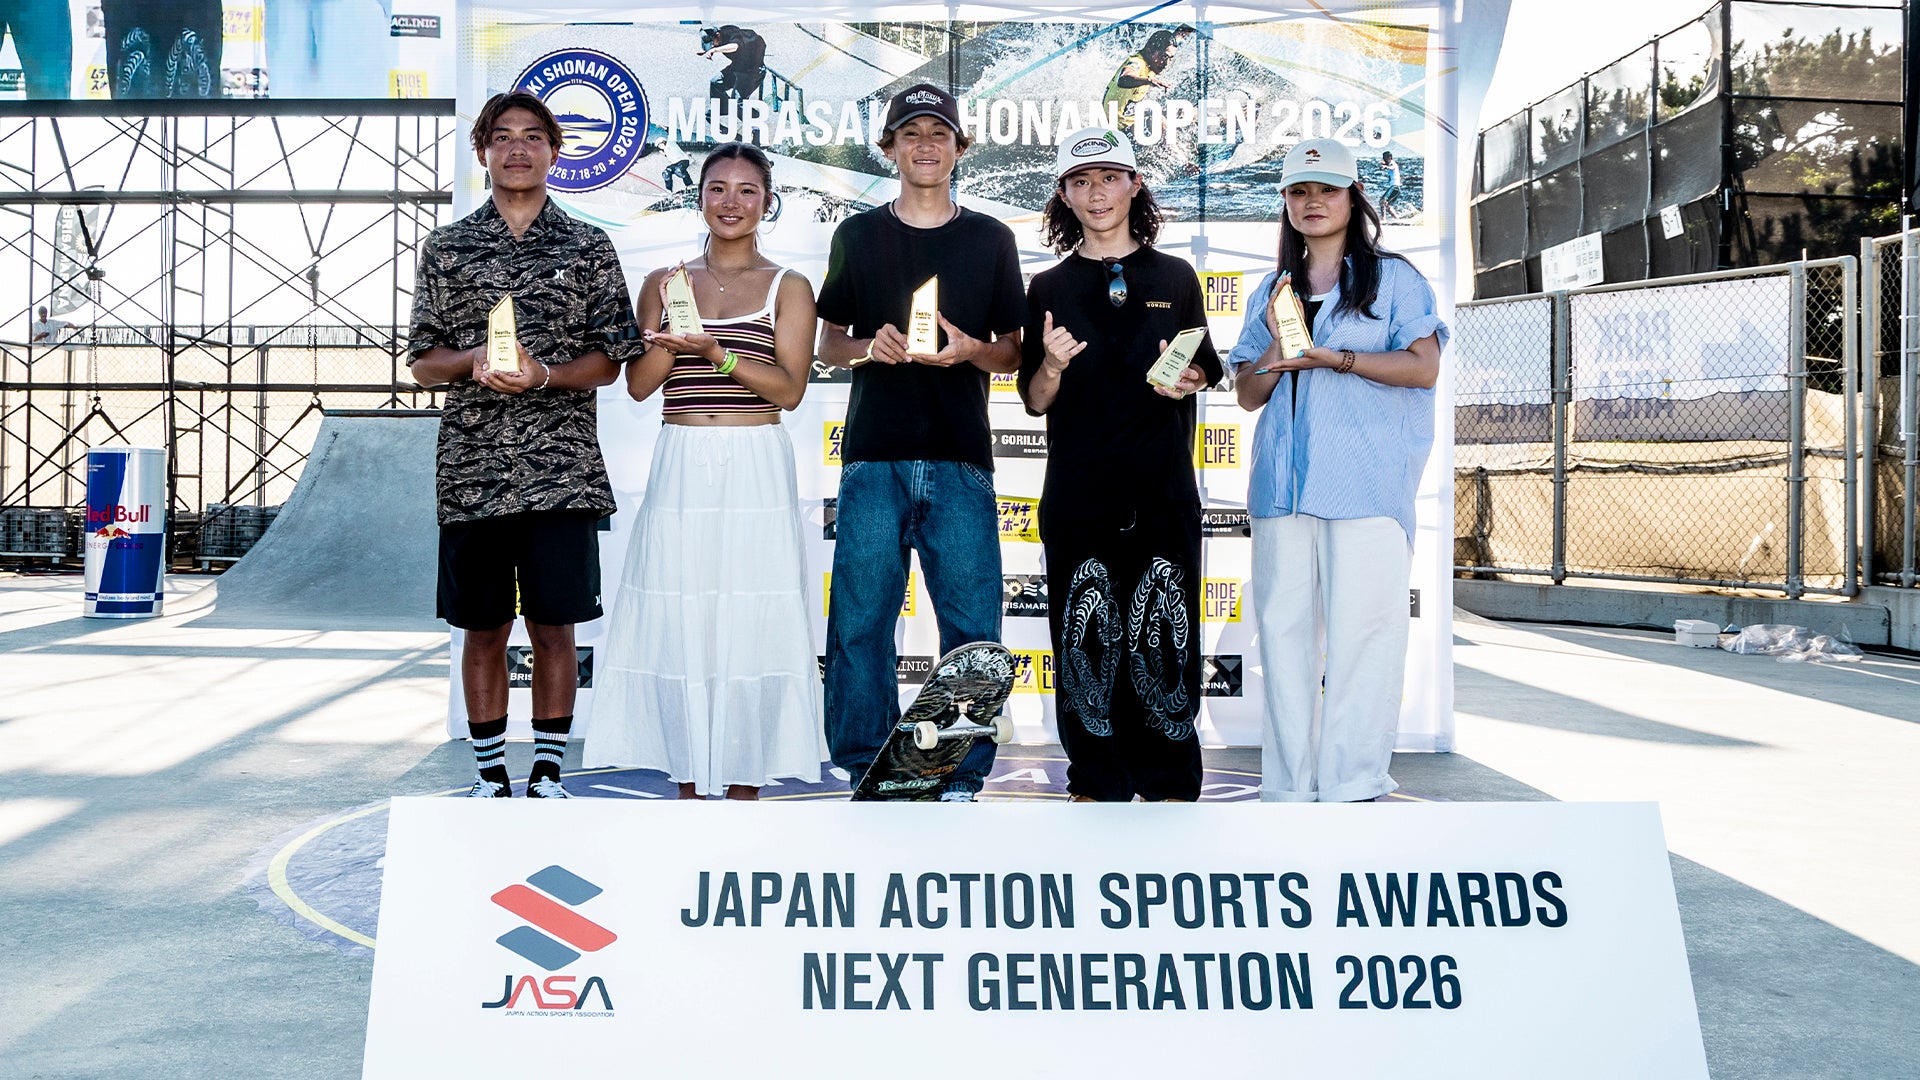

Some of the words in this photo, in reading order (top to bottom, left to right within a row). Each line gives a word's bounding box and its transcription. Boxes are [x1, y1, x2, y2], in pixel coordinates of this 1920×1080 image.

[543, 60, 609, 82] SHONAN
[607, 74, 637, 113] OPEN
[668, 96, 893, 146] MURASAK
[958, 99, 1119, 146] HONAN
[1134, 100, 1257, 146] OPEN
[1271, 101, 1393, 149] 2026
[612, 116, 638, 158] 2026
[548, 162, 607, 180] 026.7.18-20
[1206, 276, 1238, 294] RIDE
[1206, 294, 1238, 312] LIFE
[1204, 428, 1236, 446] RIDE
[1204, 446, 1236, 464] LIFE
[114, 504, 149, 523] Bull
[1205, 582, 1236, 599] RIDE
[1002, 601, 1049, 610] RISAMARI
[1205, 601, 1237, 617] LIFE
[680, 871, 856, 928] JAPAN
[879, 871, 1076, 930] ACTION
[1099, 872, 1313, 930] SPORTS
[1335, 871, 1568, 928] AWARDS
[802, 952, 944, 1011] NEXT
[967, 951, 1314, 1012] GENERATION
[1335, 954, 1463, 1010] 2026
[481, 975, 614, 1011] JASA
